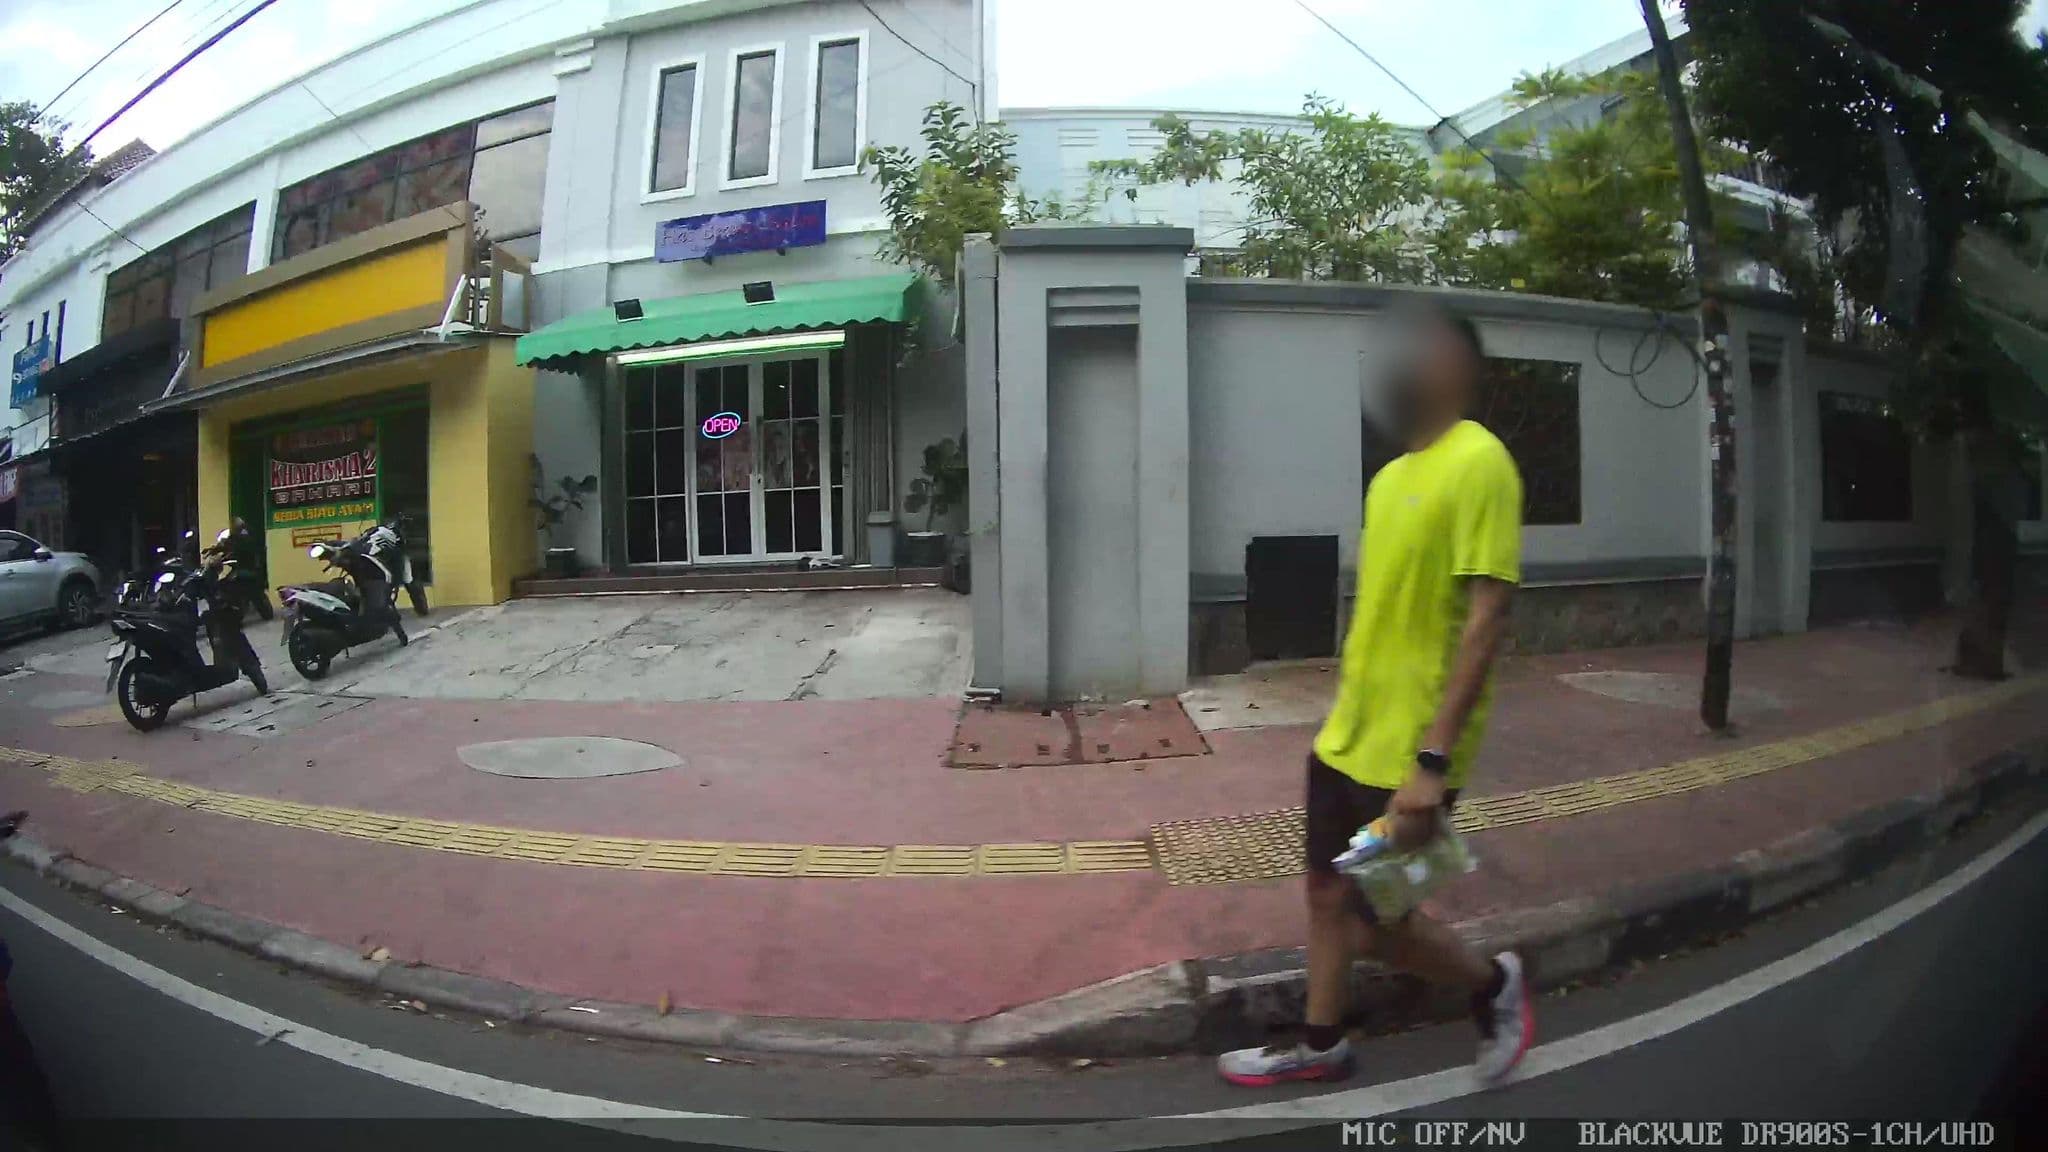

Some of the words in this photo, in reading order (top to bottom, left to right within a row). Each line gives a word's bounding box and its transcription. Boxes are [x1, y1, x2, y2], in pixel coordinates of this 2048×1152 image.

[705, 418, 738, 432] OPEN
[271, 451, 362, 489] KHARISMA
[363, 446, 377, 477] 2
[274, 481, 371, 504] BAHARI
